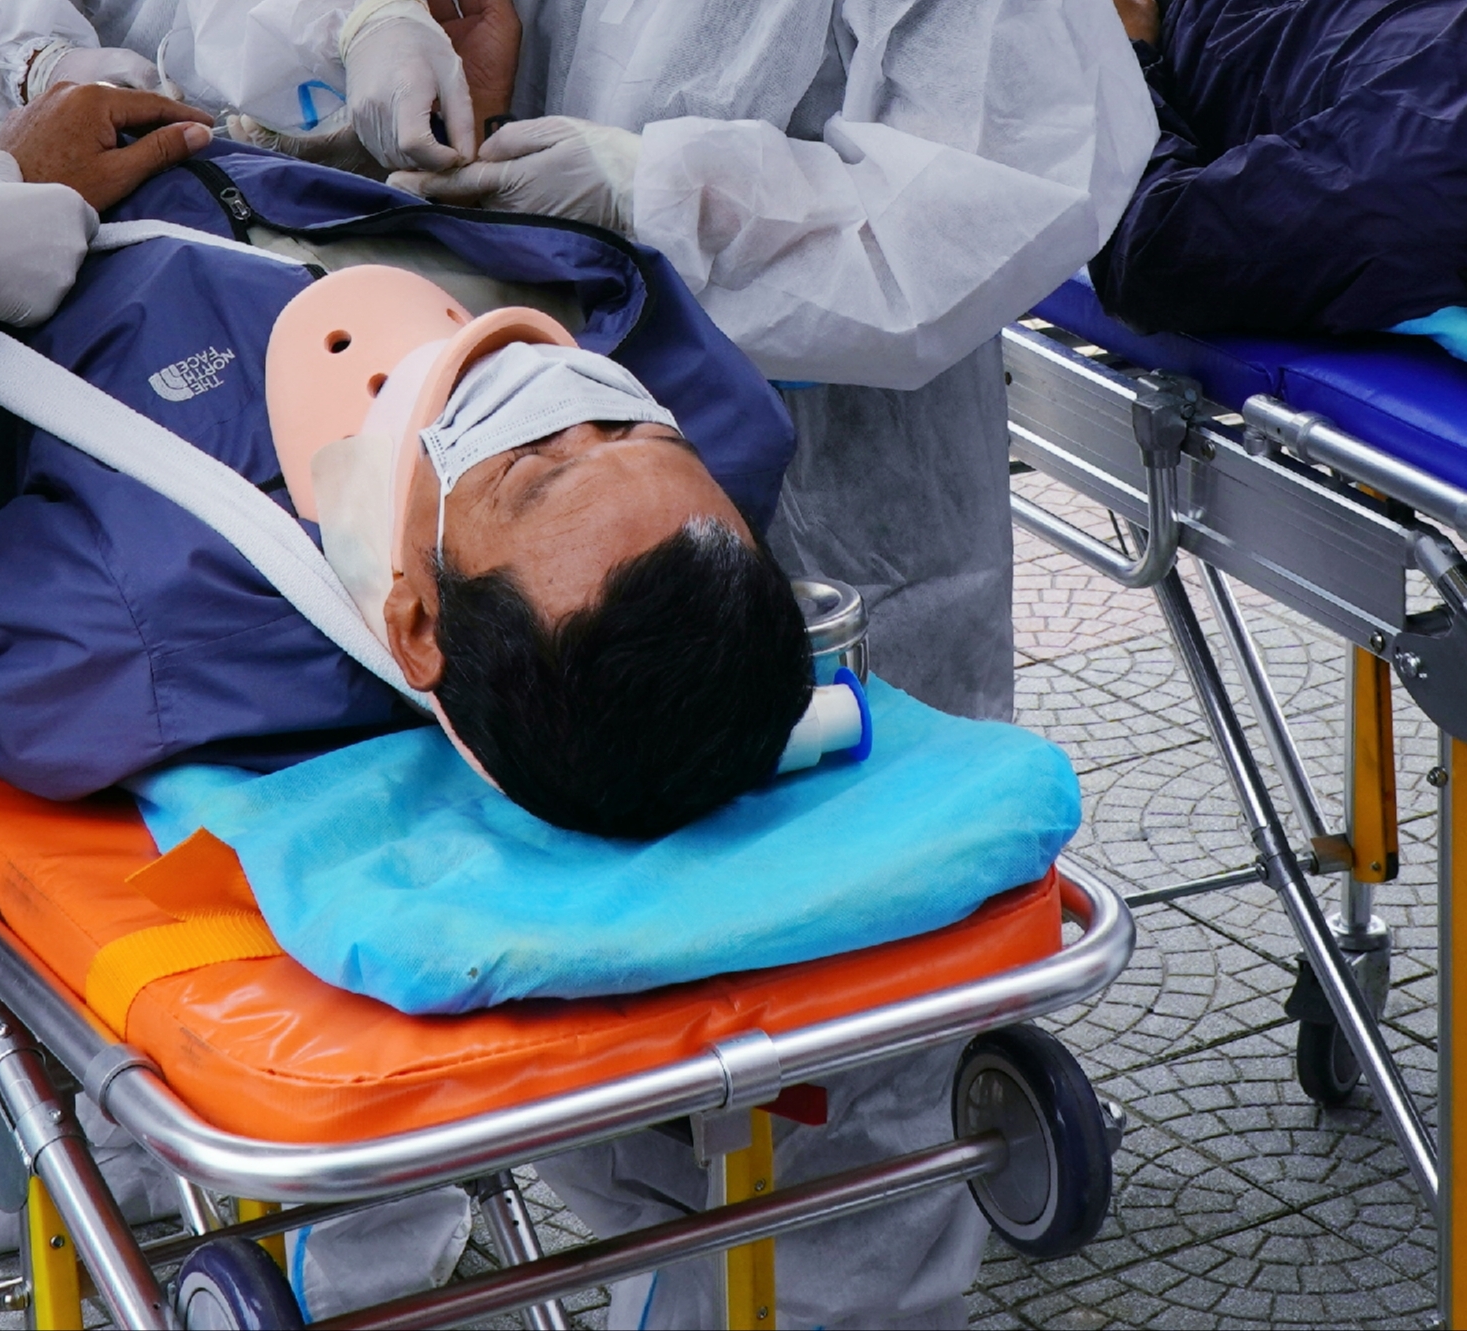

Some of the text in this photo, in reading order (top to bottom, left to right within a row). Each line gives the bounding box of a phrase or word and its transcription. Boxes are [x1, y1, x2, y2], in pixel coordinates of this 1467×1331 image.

[175, 346, 220, 375] FACE
[183, 347, 236, 385] NORTH
[190, 374, 224, 395] THE
